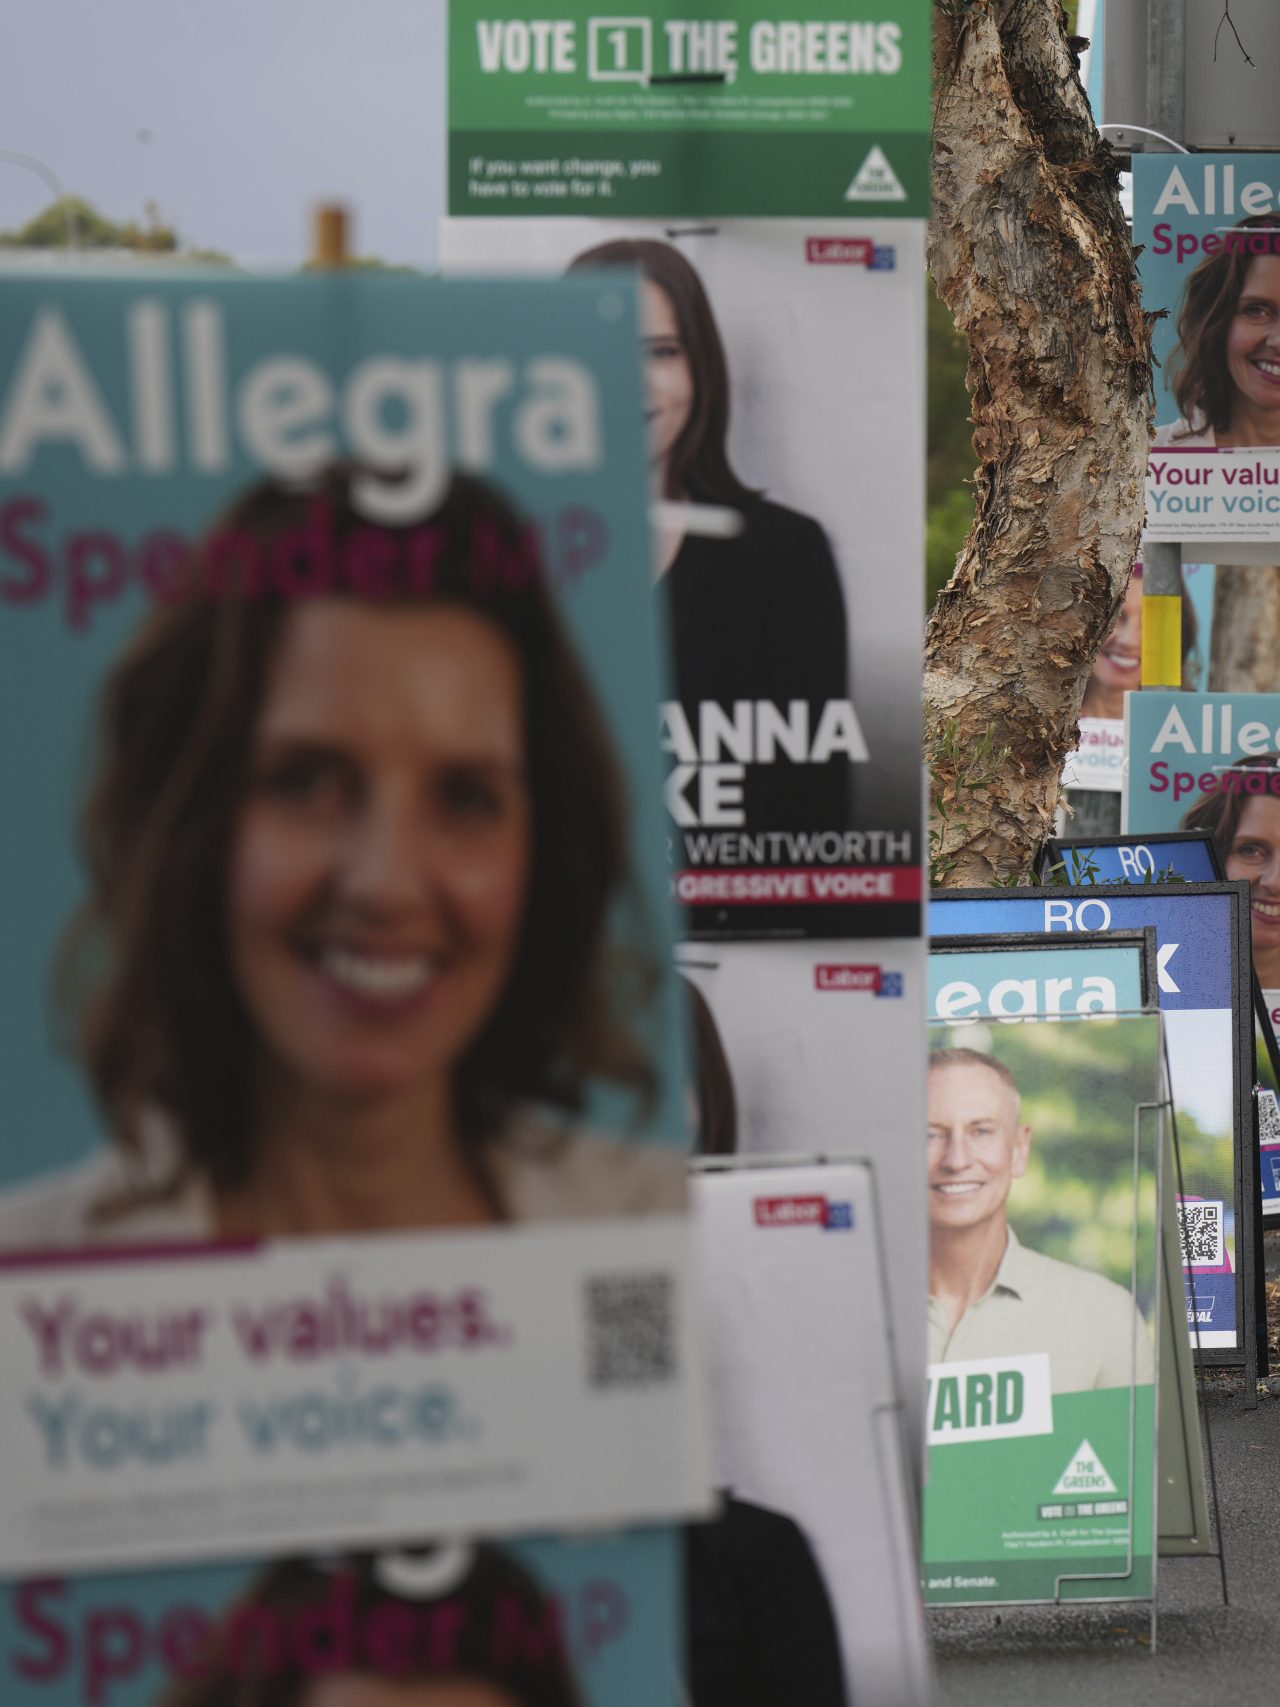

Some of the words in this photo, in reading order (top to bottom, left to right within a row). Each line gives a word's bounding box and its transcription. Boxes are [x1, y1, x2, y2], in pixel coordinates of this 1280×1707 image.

[476, 20, 577, 74] VOTE
[608, 29, 628, 70] 1
[664, 20, 738, 75] THE
[749, 20, 903, 75] GREENS
[469, 157, 483, 175] If
[485, 161, 515, 181] you
[519, 158, 560, 175] want
[564, 158, 624, 180] change,
[628, 161, 661, 180] you
[469, 178, 511, 196] have
[514, 181, 531, 196] to
[534, 181, 567, 196] vote
[569, 178, 596, 196] for
[811, 240, 868, 260] Labor
[0, 300, 600, 526] Allegra
[1149, 463, 1214, 485] Your
[1149, 490, 1211, 513] Your
[0, 497, 442, 638] Spender
[475, 509, 610, 594] MP
[685, 831, 912, 865] WENTWORTH
[1118, 845, 1155, 877] RO
[812, 872, 895, 896] VOICE
[818, 966, 878, 988] Labor
[758, 1201, 824, 1226] Labor
[18, 1290, 212, 1378] Your
[230, 1270, 512, 1368] values.
[27, 1388, 212, 1470] Your
[238, 1370, 480, 1452] voice.
[1076, 1461, 1095, 1474] THE
[1063, 1475, 1107, 1489] GREENS
[928, 1576, 952, 1589] and
[953, 1575, 1000, 1589] Senate.
[10, 1562, 470, 1707] Spender
[494, 1578, 632, 1665] MP
